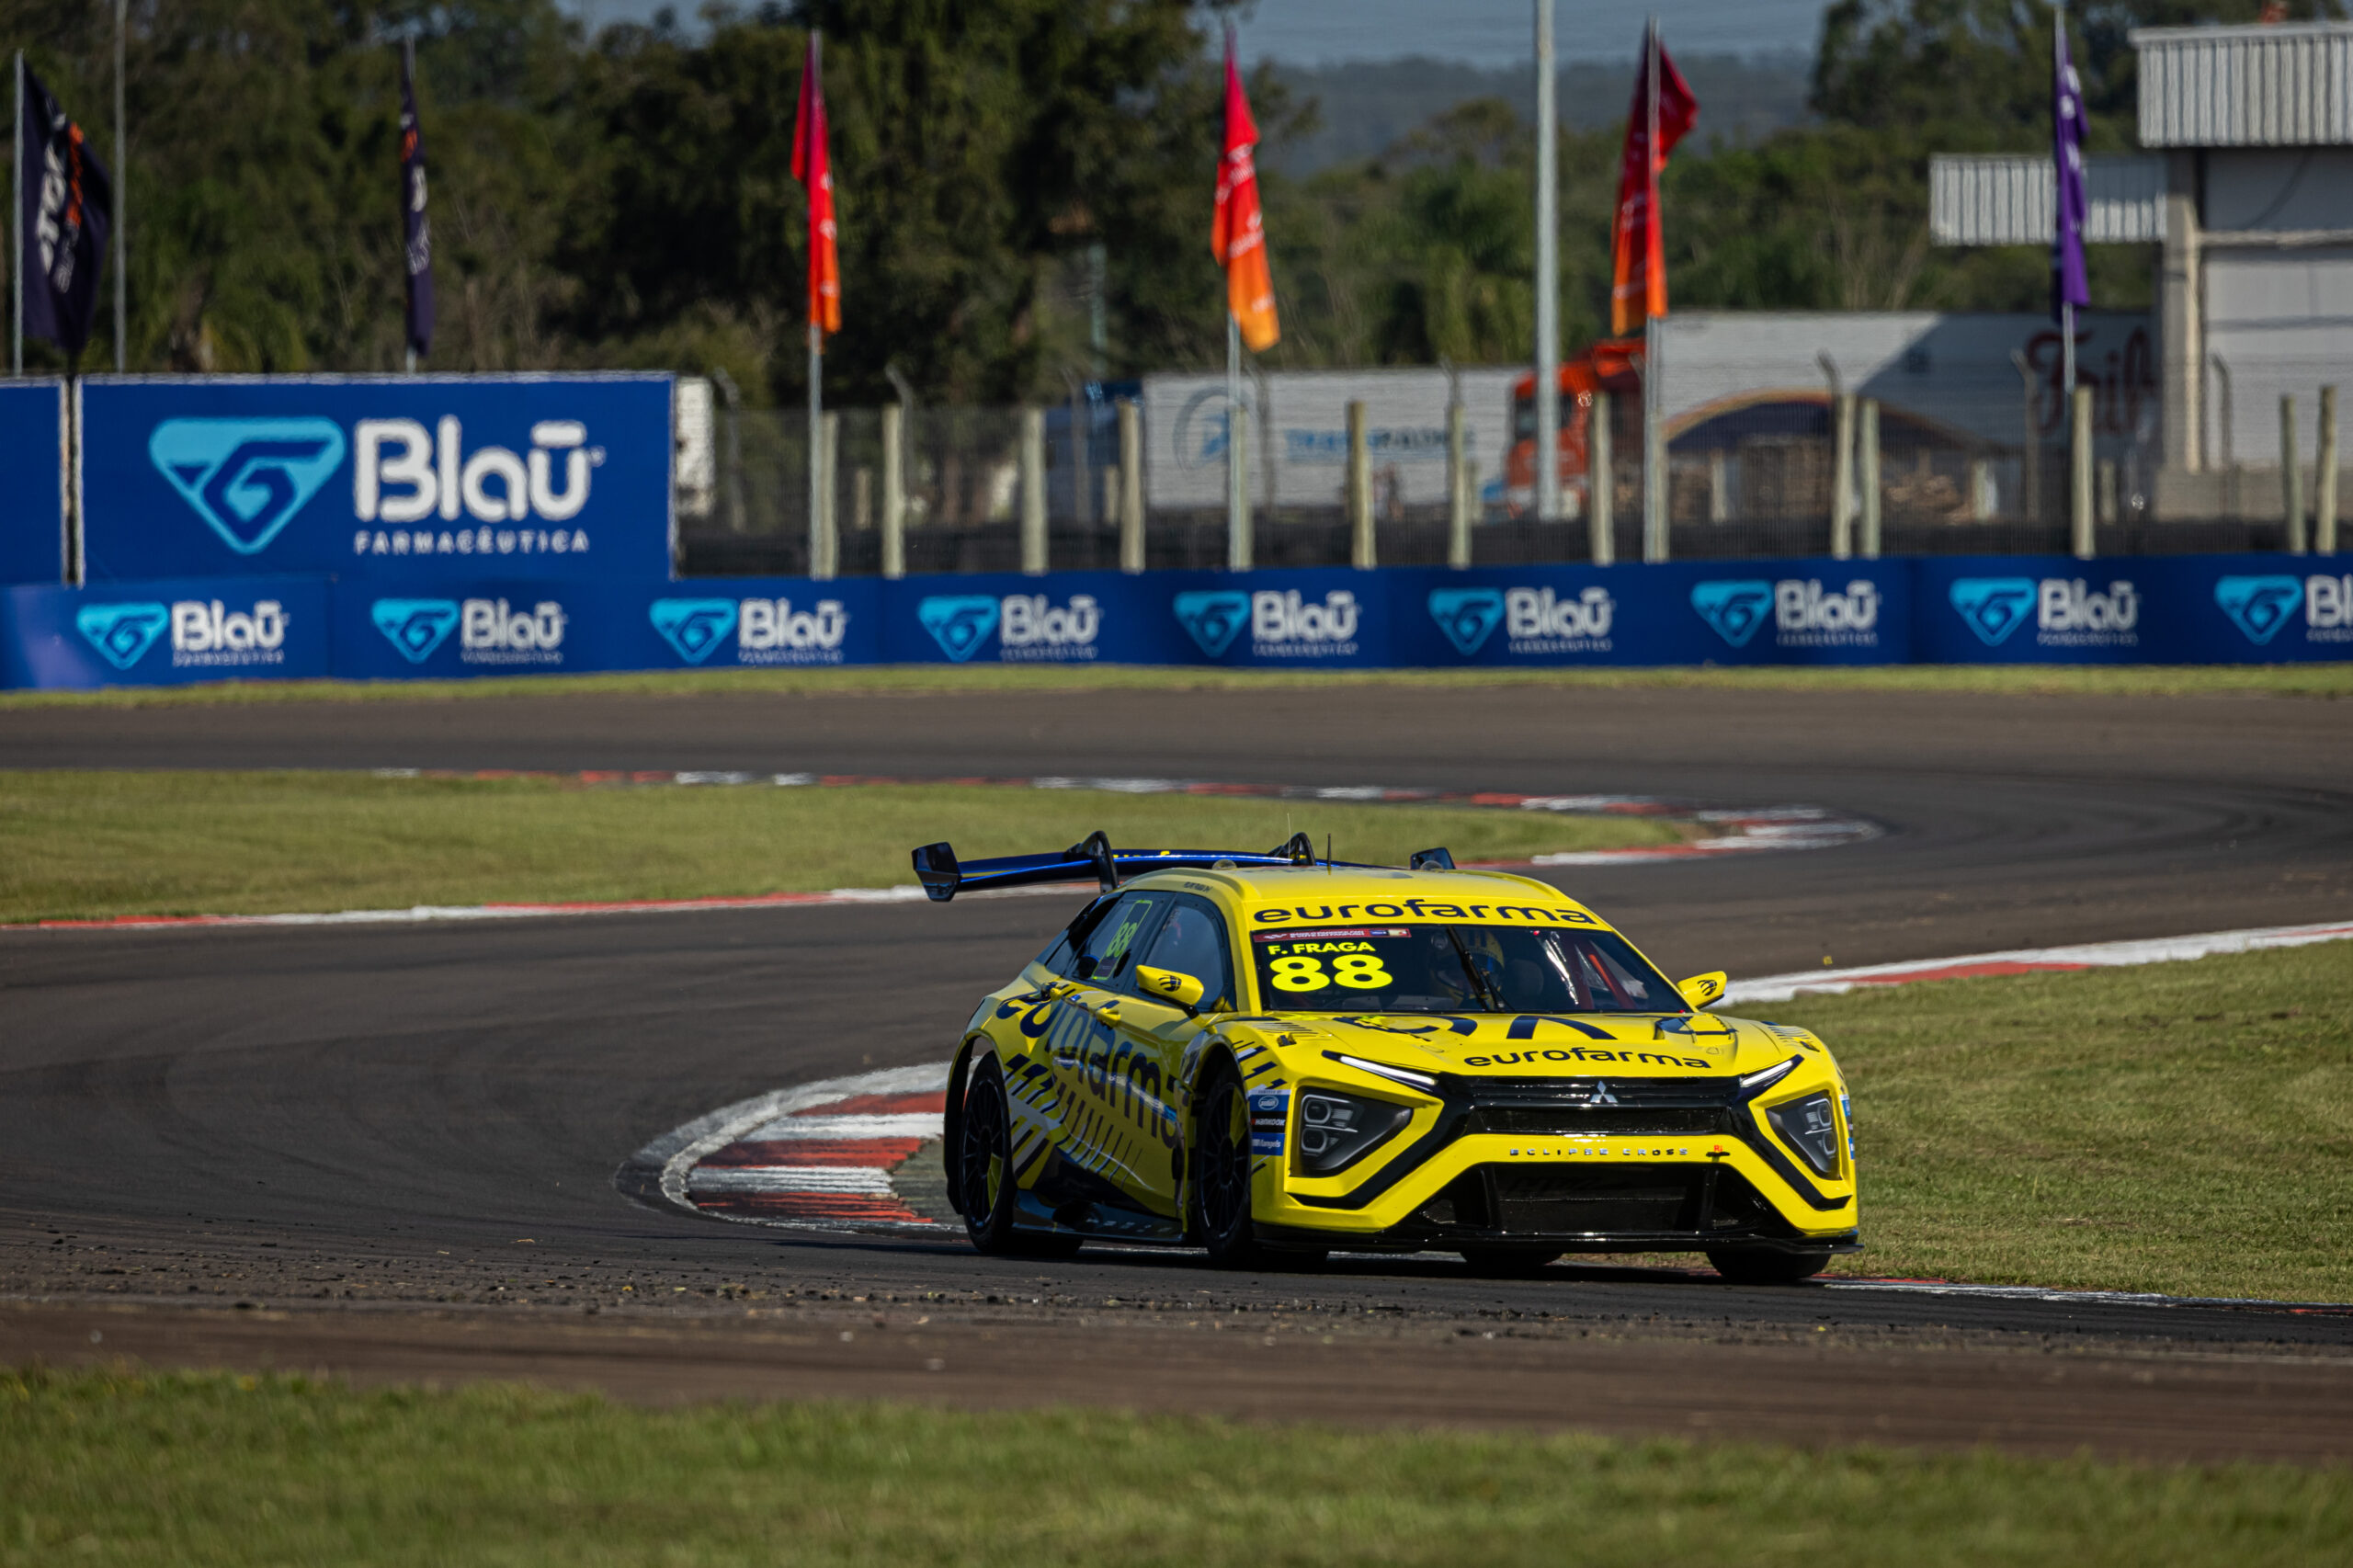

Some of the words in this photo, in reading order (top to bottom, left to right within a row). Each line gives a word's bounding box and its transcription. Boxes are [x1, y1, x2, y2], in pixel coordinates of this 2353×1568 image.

[354, 526, 589, 555] FARMACÊUTICA
[1254, 899, 1597, 925] eurofarma
[1267, 945, 1289, 955] F.
[1292, 941, 1376, 954] FRAGA
[1269, 954, 1392, 992] 88
[1464, 1046, 1711, 1069] eurofarma
[1509, 1148, 1608, 1156] ECLIPSE
[1622, 1148, 1688, 1156] CROSS
